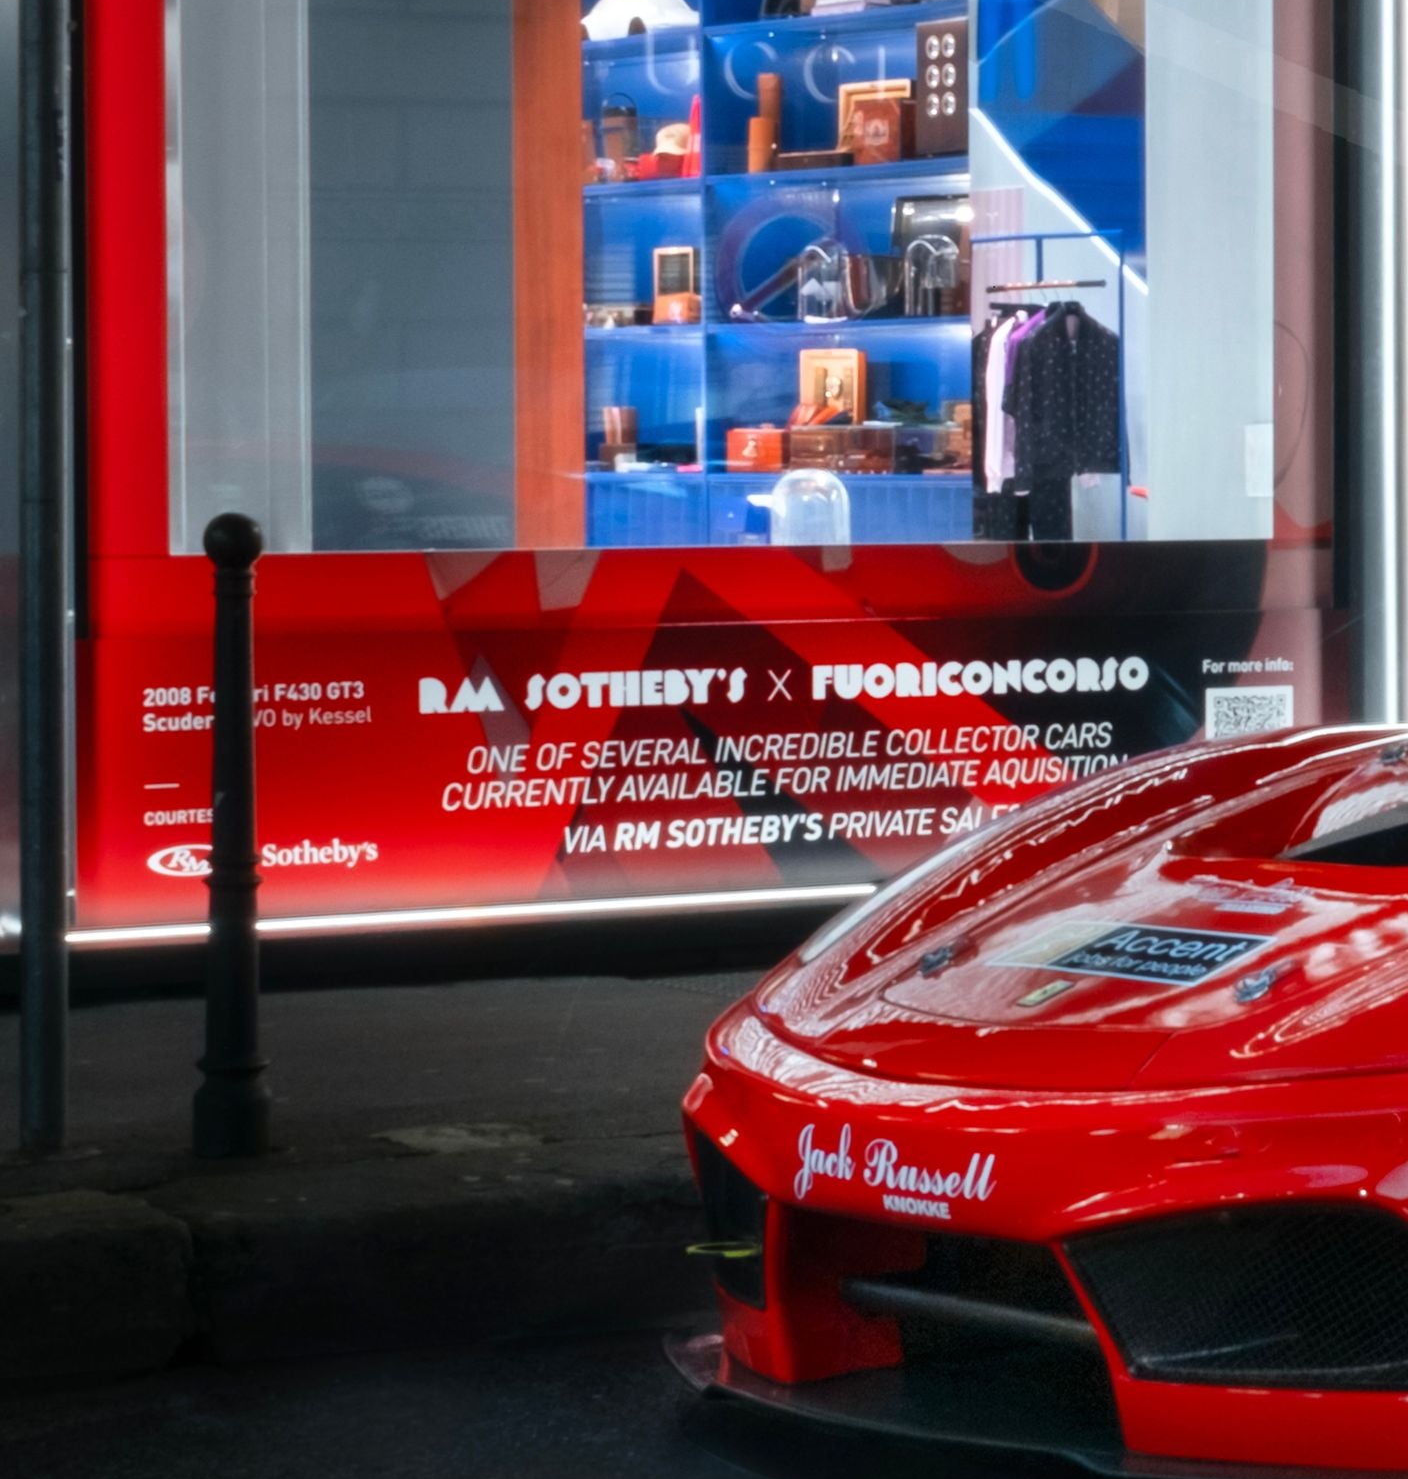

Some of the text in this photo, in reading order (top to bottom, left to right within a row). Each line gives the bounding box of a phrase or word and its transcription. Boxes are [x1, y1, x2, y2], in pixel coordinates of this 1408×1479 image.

[1202, 657, 1294, 674] For more info:
[143, 687, 192, 707] 2008
[273, 682, 322, 702] F430
[327, 680, 365, 700] GT3
[418, 676, 506, 714] RM
[524, 668, 748, 709] SOTHEBY'S
[811, 655, 1149, 701] FUORICONCORSO
[143, 711, 215, 733] Scuder
[282, 709, 303, 730] by
[309, 705, 372, 725] Kessel
[466, 721, 1112, 774] ONE OF SEVERAL INCREDIBLE COLLECTOR CARS
[441, 775, 615, 812] CURRENTLY
[616, 768, 769, 802] AVAILABLE
[774, 765, 829, 795] FOR
[836, 759, 977, 793] IMMEDIATE
[144, 807, 214, 827] COURTES
[563, 824, 607, 855] VIA
[613, 820, 661, 850] RM
[665, 813, 822, 849] SOTHEBY'S
[828, 807, 933, 841] PRIVATE
[261, 837, 379, 868] Sotheby's
[1096, 928, 1248, 960] Accent
[793, 1122, 998, 1202] Jack Russell
[882, 1193, 951, 1220] KNOKKE
